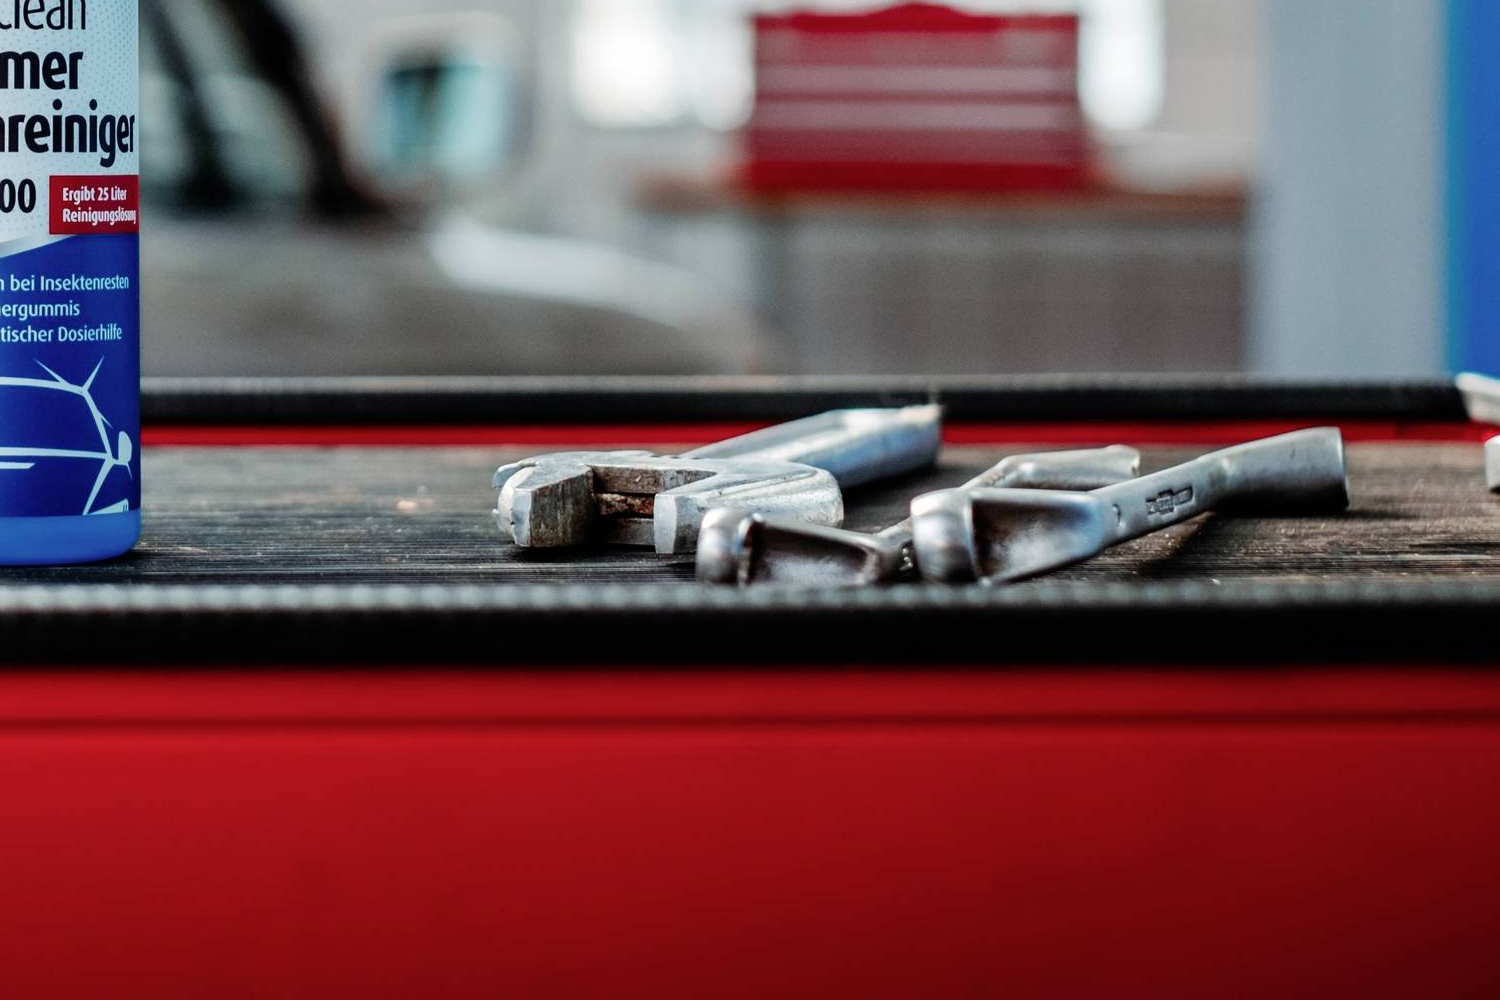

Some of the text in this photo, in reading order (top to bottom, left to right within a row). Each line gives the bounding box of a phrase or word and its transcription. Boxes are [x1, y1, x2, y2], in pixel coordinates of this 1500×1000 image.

[63, 187, 127, 204] Ergibt 25 Liter
[63, 208, 136, 226] Reinigungslösung
[10, 275, 35, 291] bei
[41, 275, 129, 291] Insektenresten
[58, 324, 122, 341] Dosierhilfe
